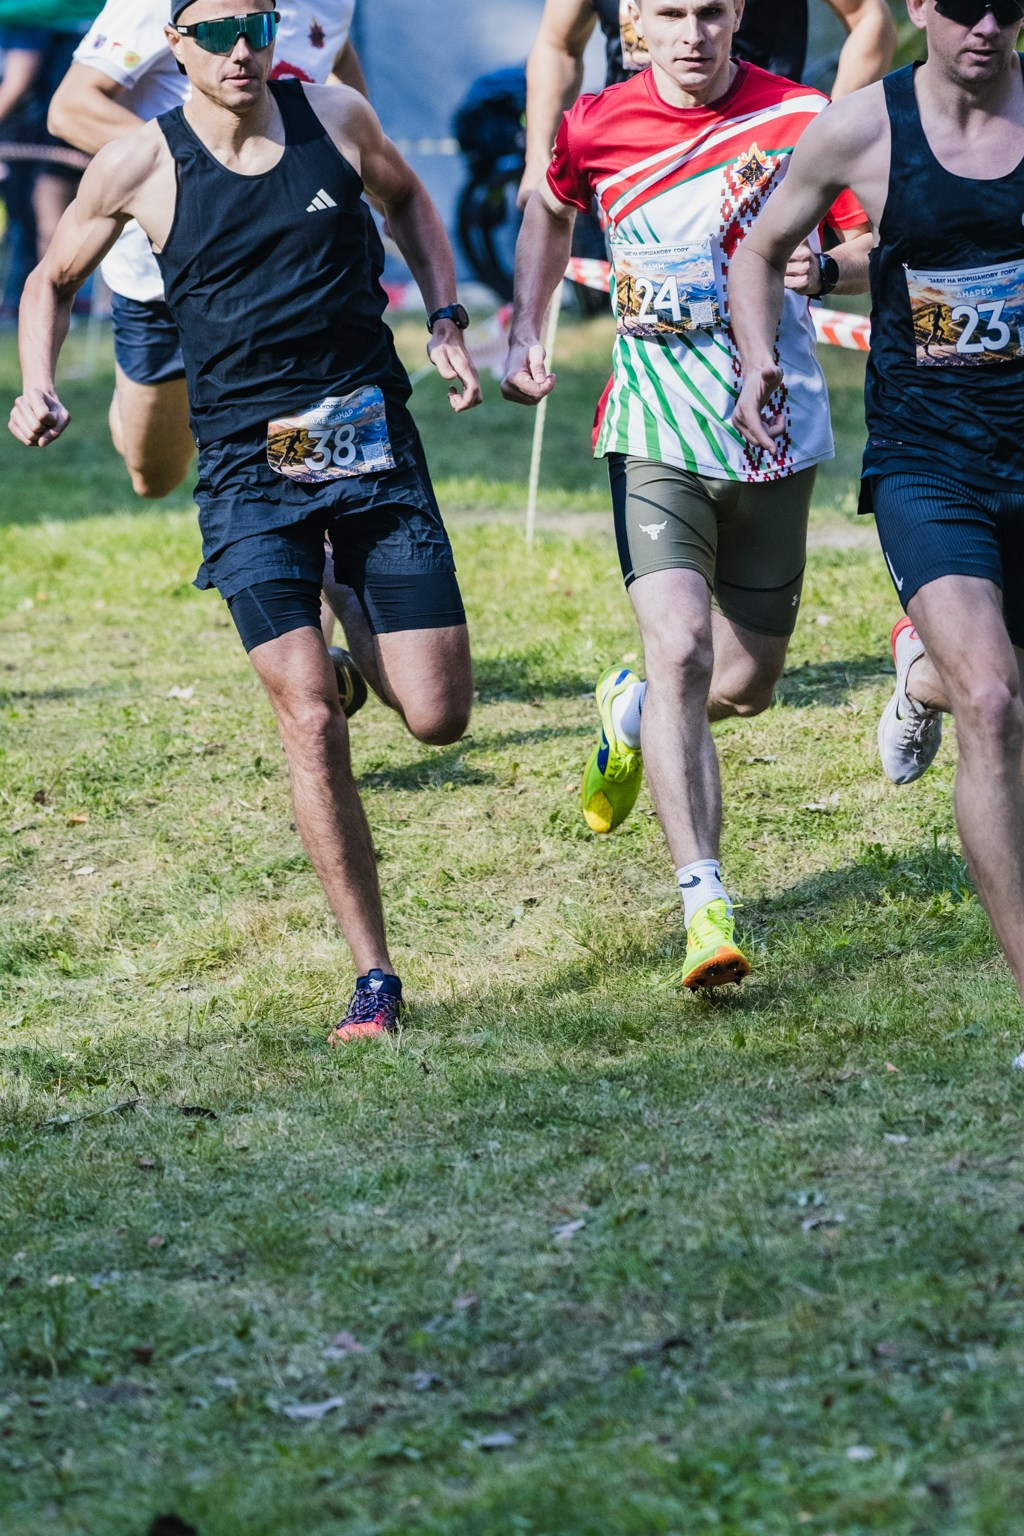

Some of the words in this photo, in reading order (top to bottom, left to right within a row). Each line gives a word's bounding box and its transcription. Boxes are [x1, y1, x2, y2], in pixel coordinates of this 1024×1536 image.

[635, 275, 682, 324] 24
[956, 285, 993, 298] АНДРЕЙ
[957, 272, 998, 283] КОРШАКОВУ
[951, 299, 1010, 354] 23
[304, 424, 356, 470] 38
